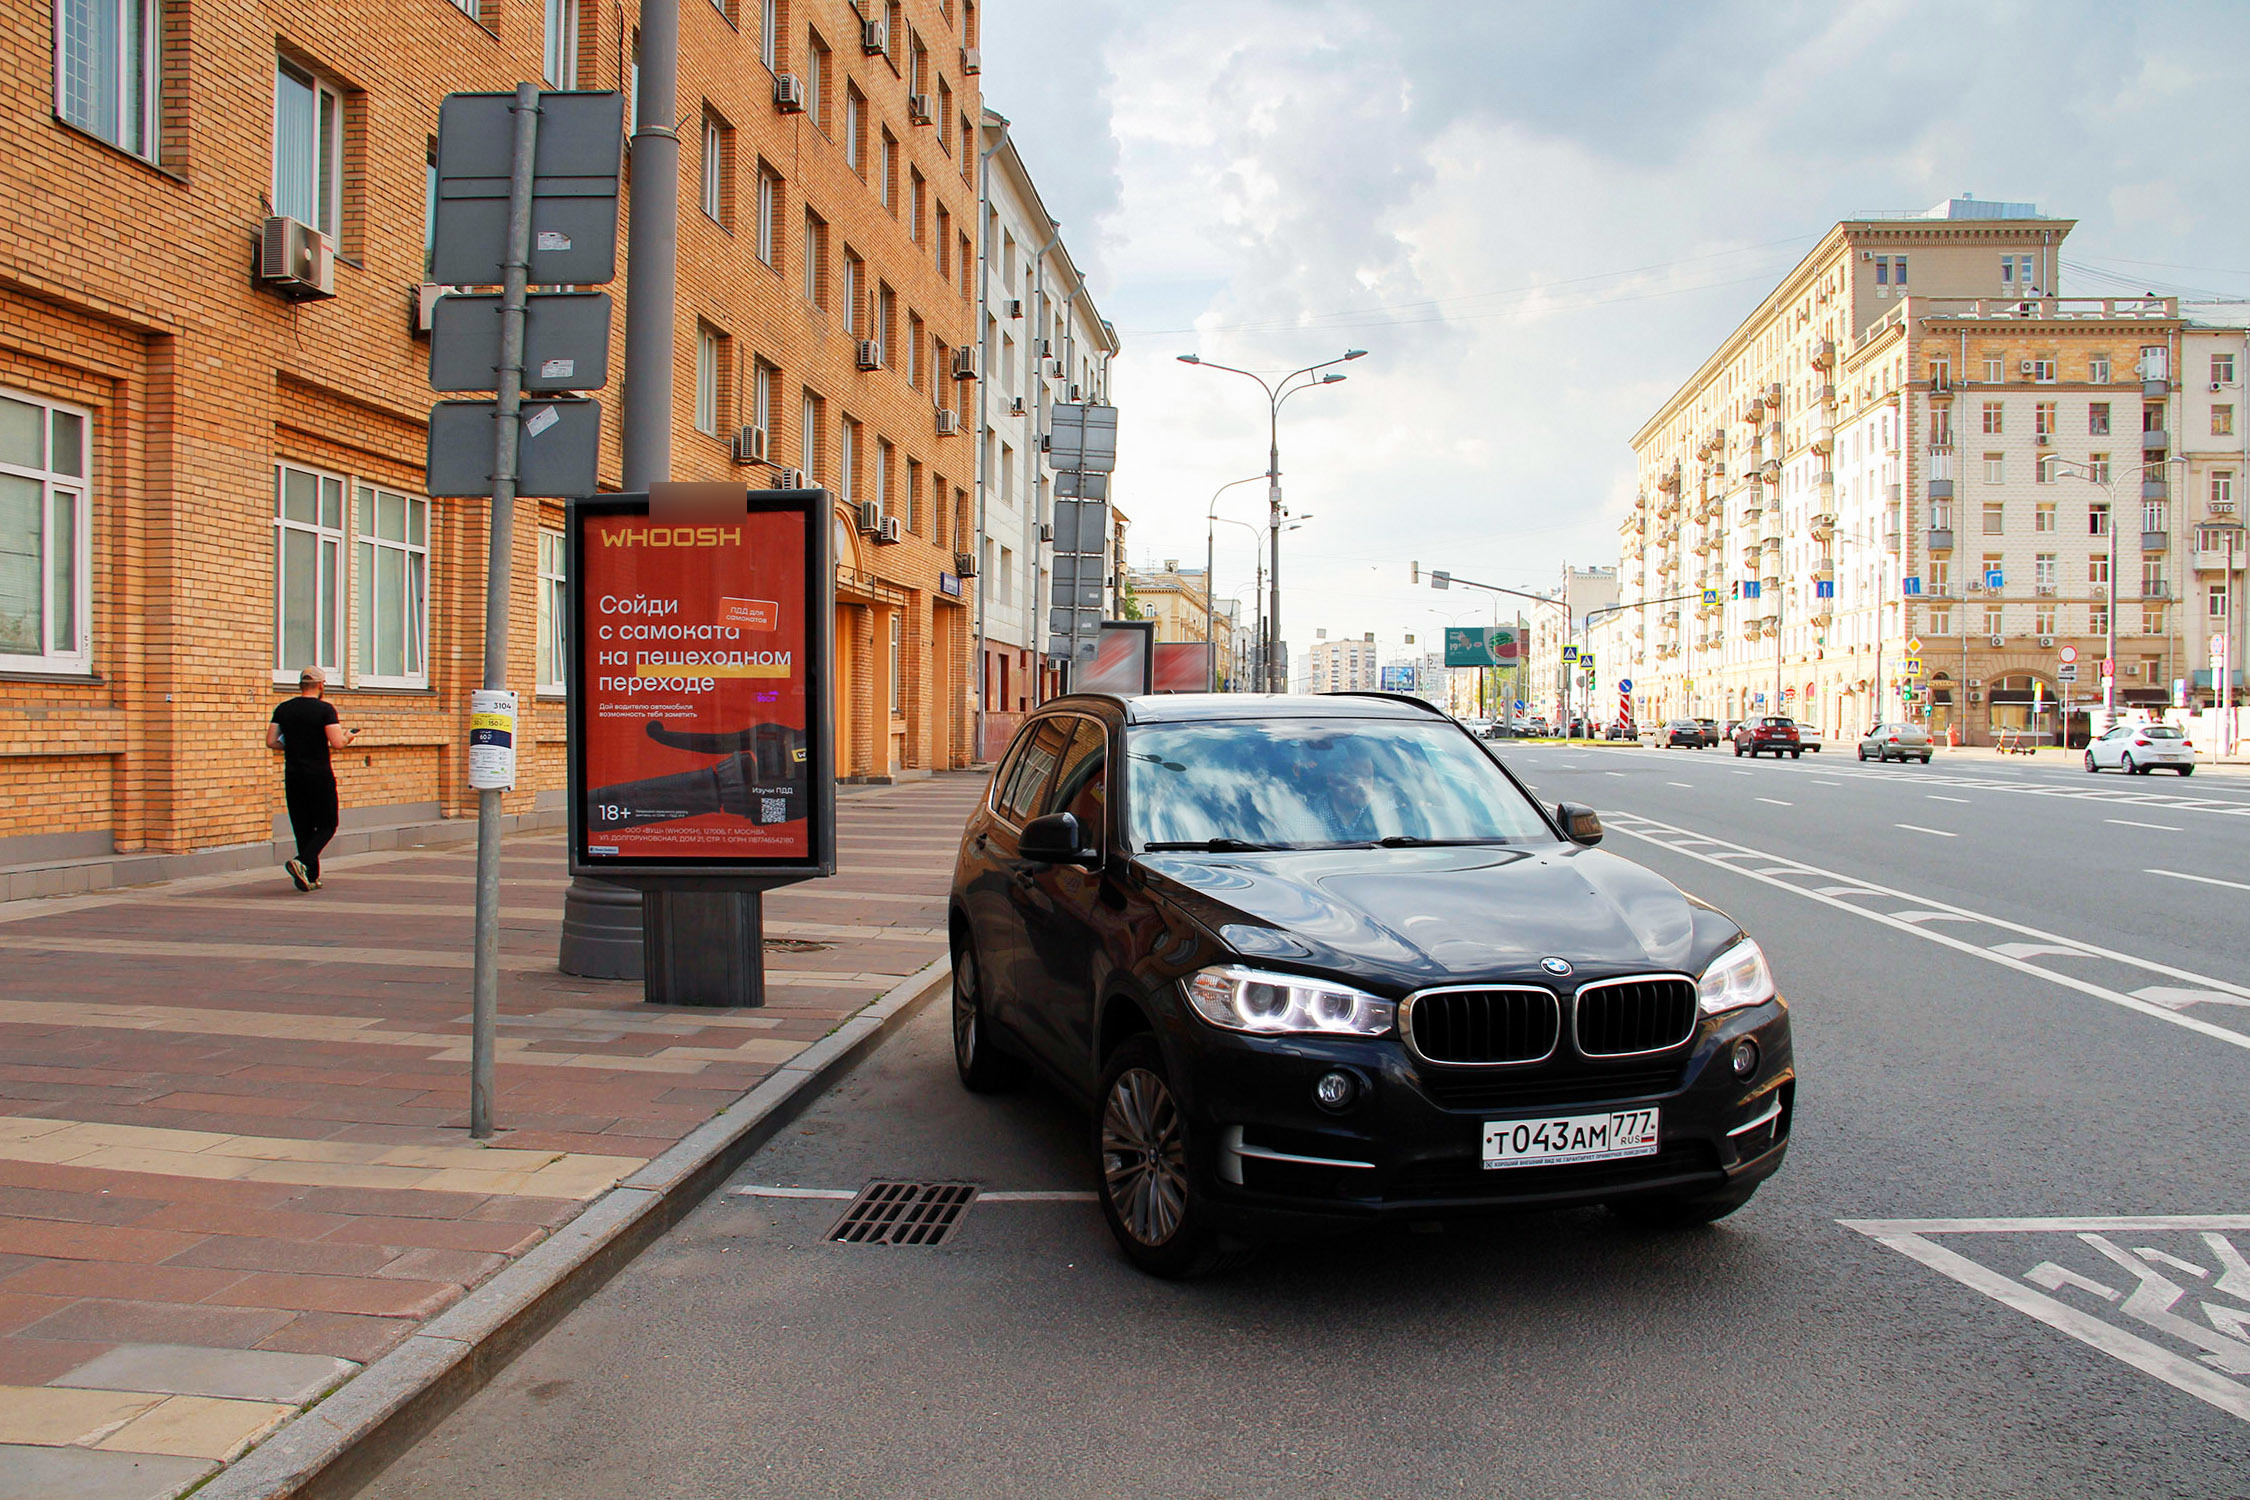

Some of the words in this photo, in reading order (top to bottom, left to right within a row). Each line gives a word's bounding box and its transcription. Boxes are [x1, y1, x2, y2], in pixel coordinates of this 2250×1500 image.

[600, 527, 741, 547] WHOOSH
[599, 594, 678, 617] Сойди
[730, 606, 748, 615] ПДД
[725, 614, 767, 624] самокатов
[599, 625, 613, 640] с
[619, 624, 740, 640] самоката
[599, 651, 628, 666] на
[636, 651, 791, 668] пешеходном
[599, 676, 715, 696] переходе
[494, 702, 512, 710] 3104
[752, 787, 775, 796] Изучи
[775, 787, 794, 796] ПДД
[599, 804, 632, 821] 18+
[1613, 1111, 1652, 1137] 777
[1620, 1136, 1640, 1145] RUS
